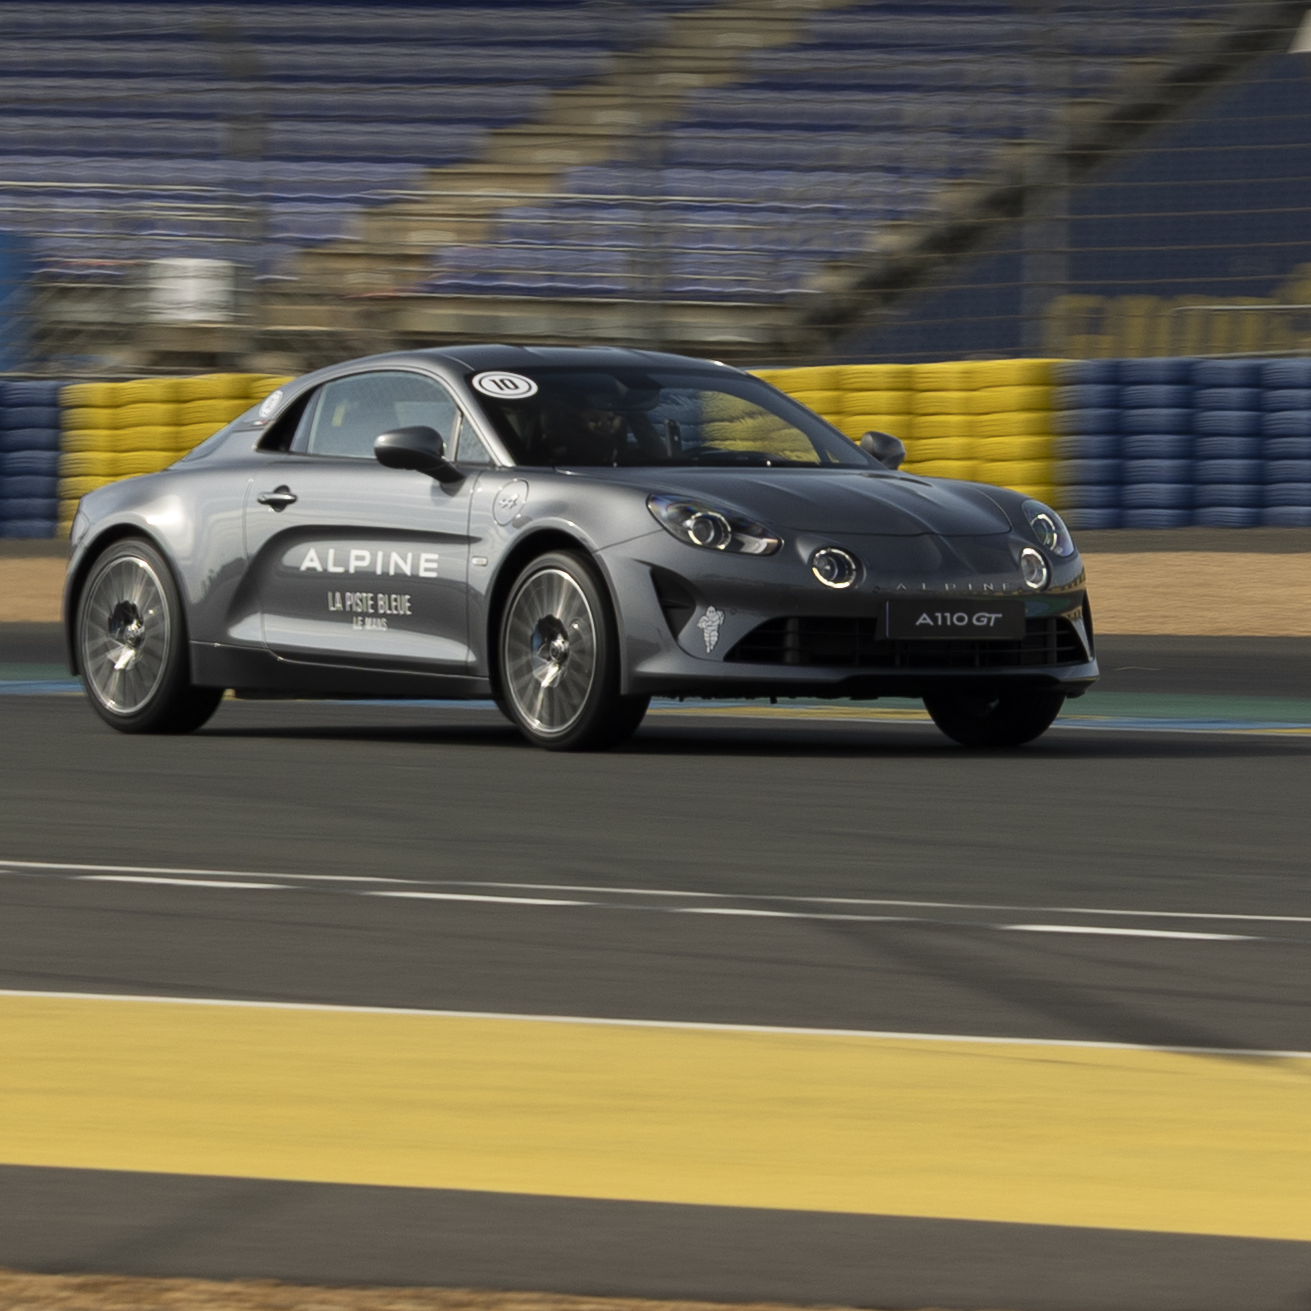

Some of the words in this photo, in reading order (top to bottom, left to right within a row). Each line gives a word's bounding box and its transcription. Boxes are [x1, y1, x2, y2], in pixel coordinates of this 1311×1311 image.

[488, 377, 520, 391] 10
[299, 547, 440, 578] ALPINE
[327, 591, 344, 611] LA
[345, 592, 376, 613] PISTE
[376, 593, 413, 615] BLEUE
[352, 616, 364, 630] LE
[915, 612, 969, 626] A110
[971, 612, 1003, 627] GT
